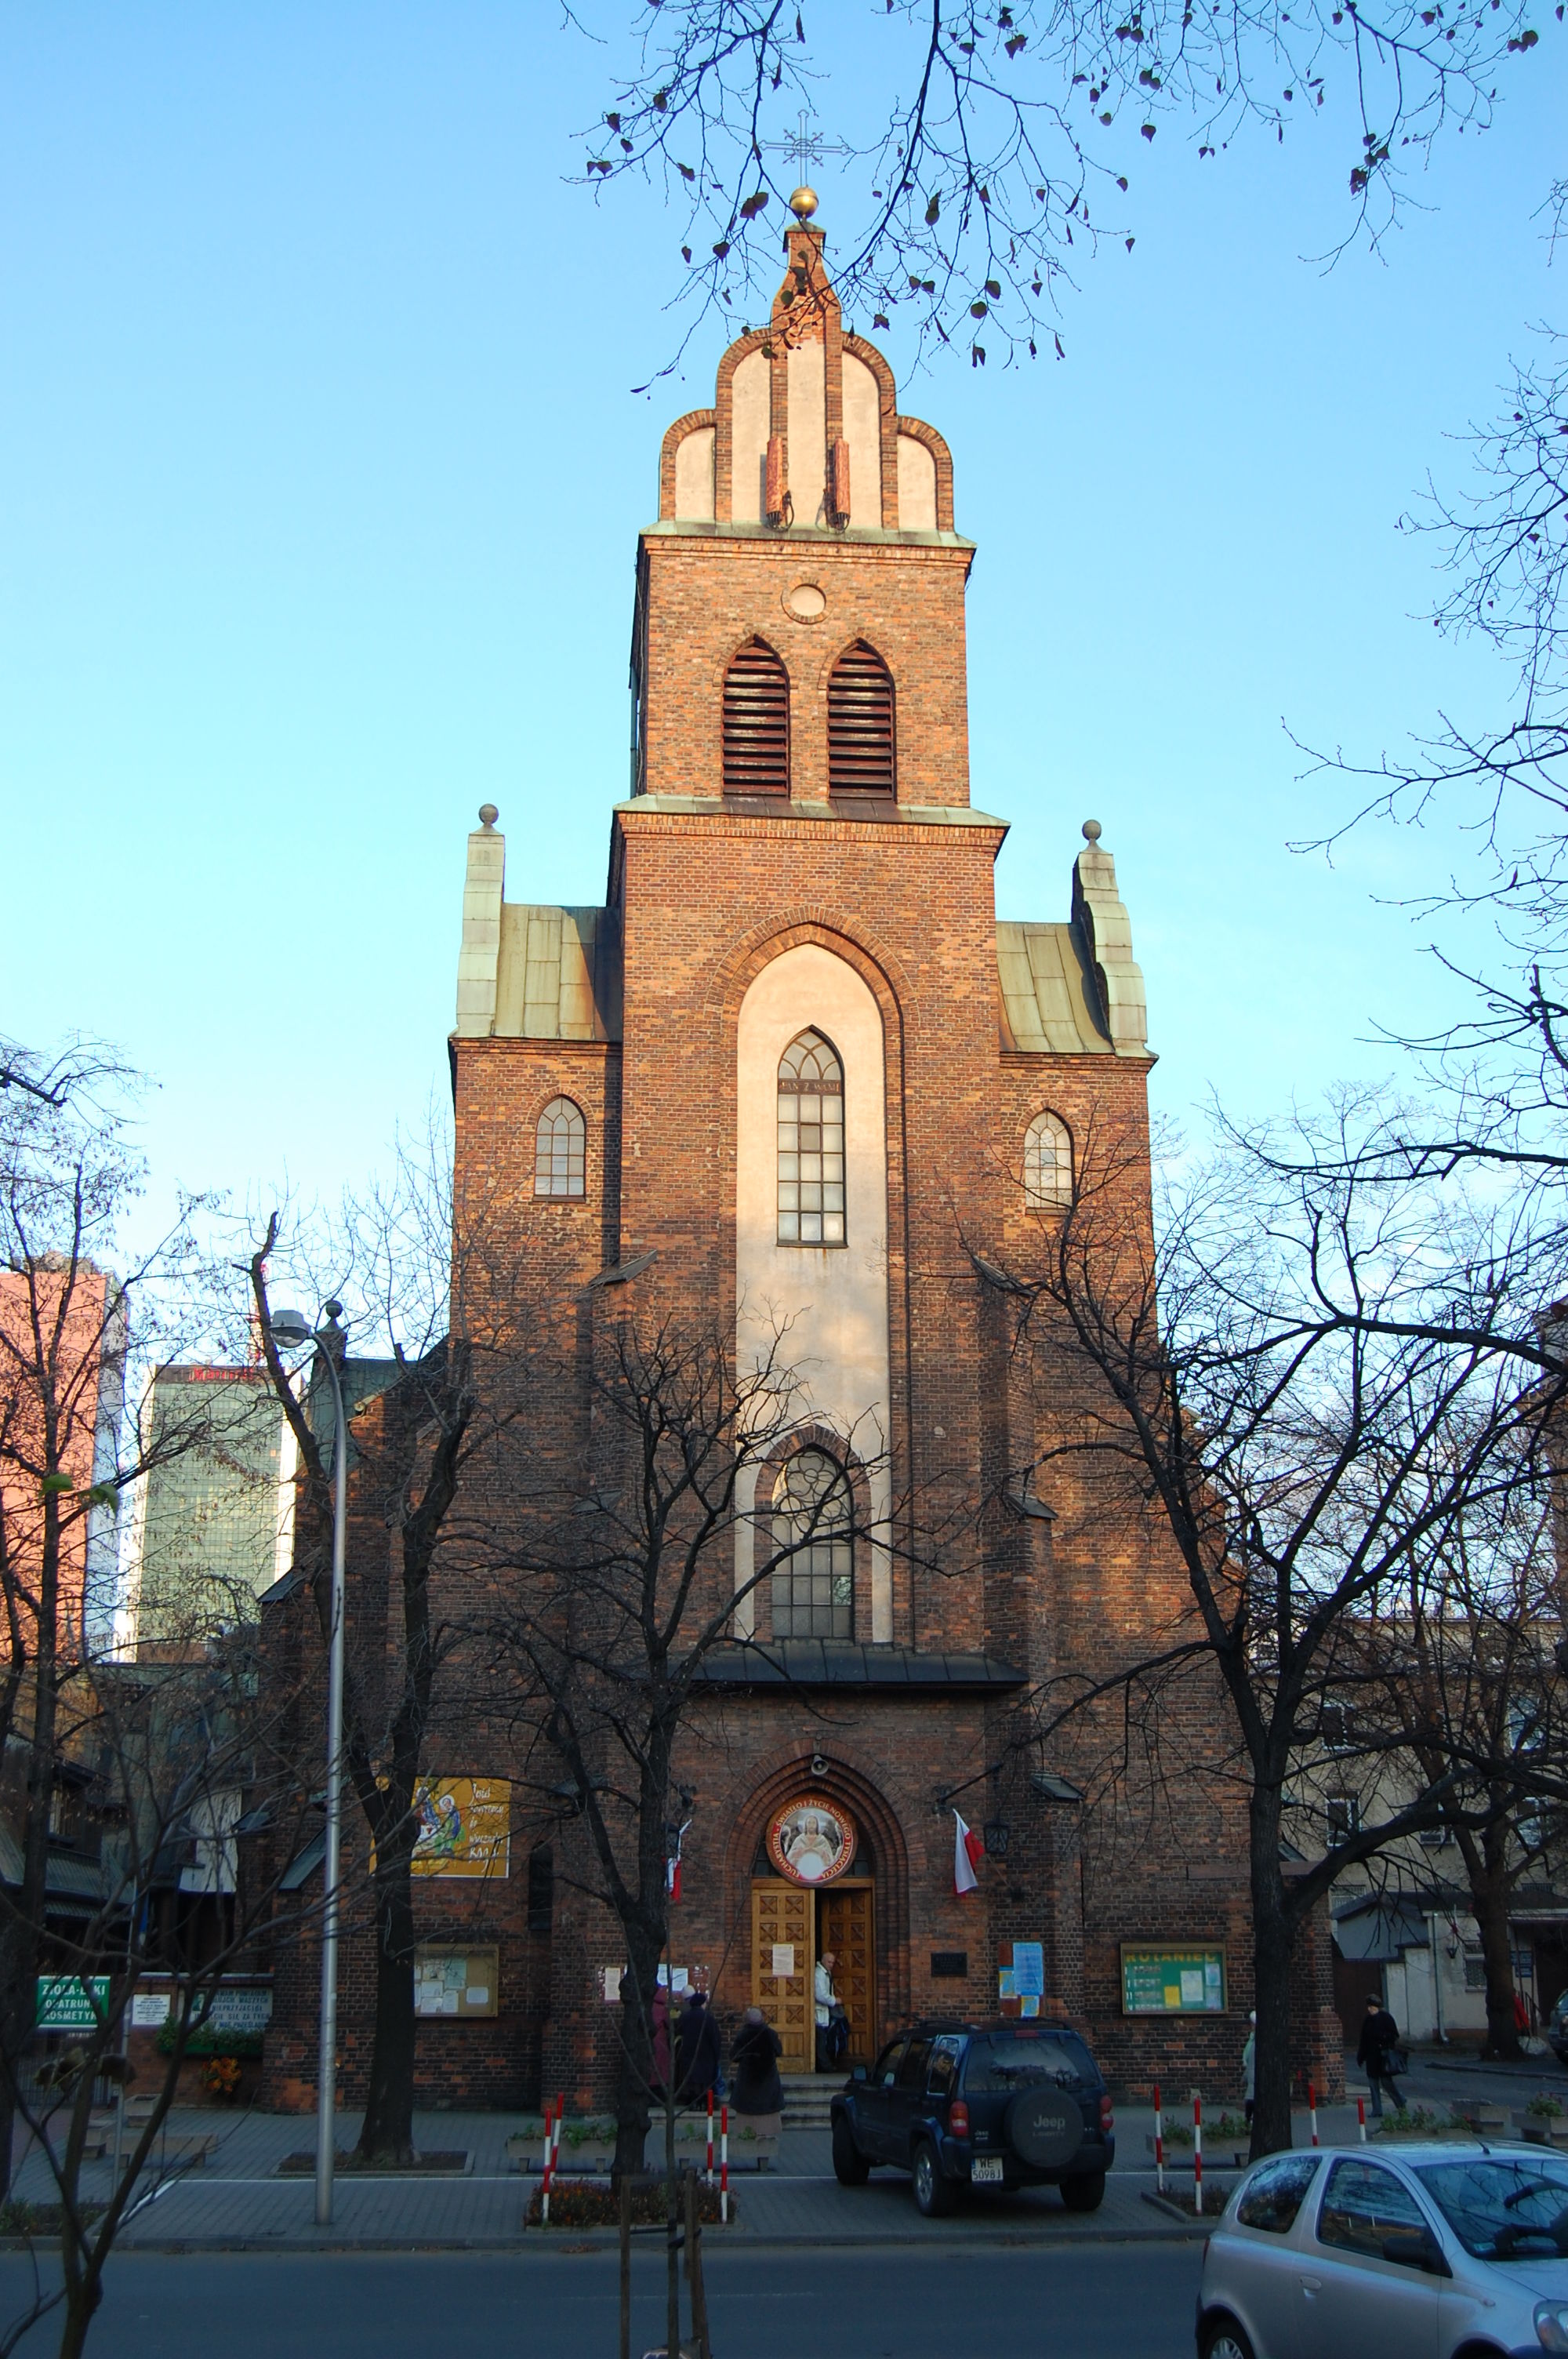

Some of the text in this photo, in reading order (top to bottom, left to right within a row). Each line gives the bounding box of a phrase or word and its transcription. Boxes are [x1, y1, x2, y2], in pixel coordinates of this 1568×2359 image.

[808, 1798, 829, 1810] ŻYCIE
[776, 1801, 803, 1826] ŚWIATŁO
[830, 1806, 851, 1839] NOWEGO
[772, 1833, 800, 1878] EUCHARYSTIA
[821, 1841, 851, 1879] TYSIĄCLECIA
[42, 1984, 105, 1995] ZOŁA-LKI
[1033, 2114, 1066, 2129] Jeep
[980, 2158, 994, 2168] WE
[972, 2169, 1001, 2180] 5098J
